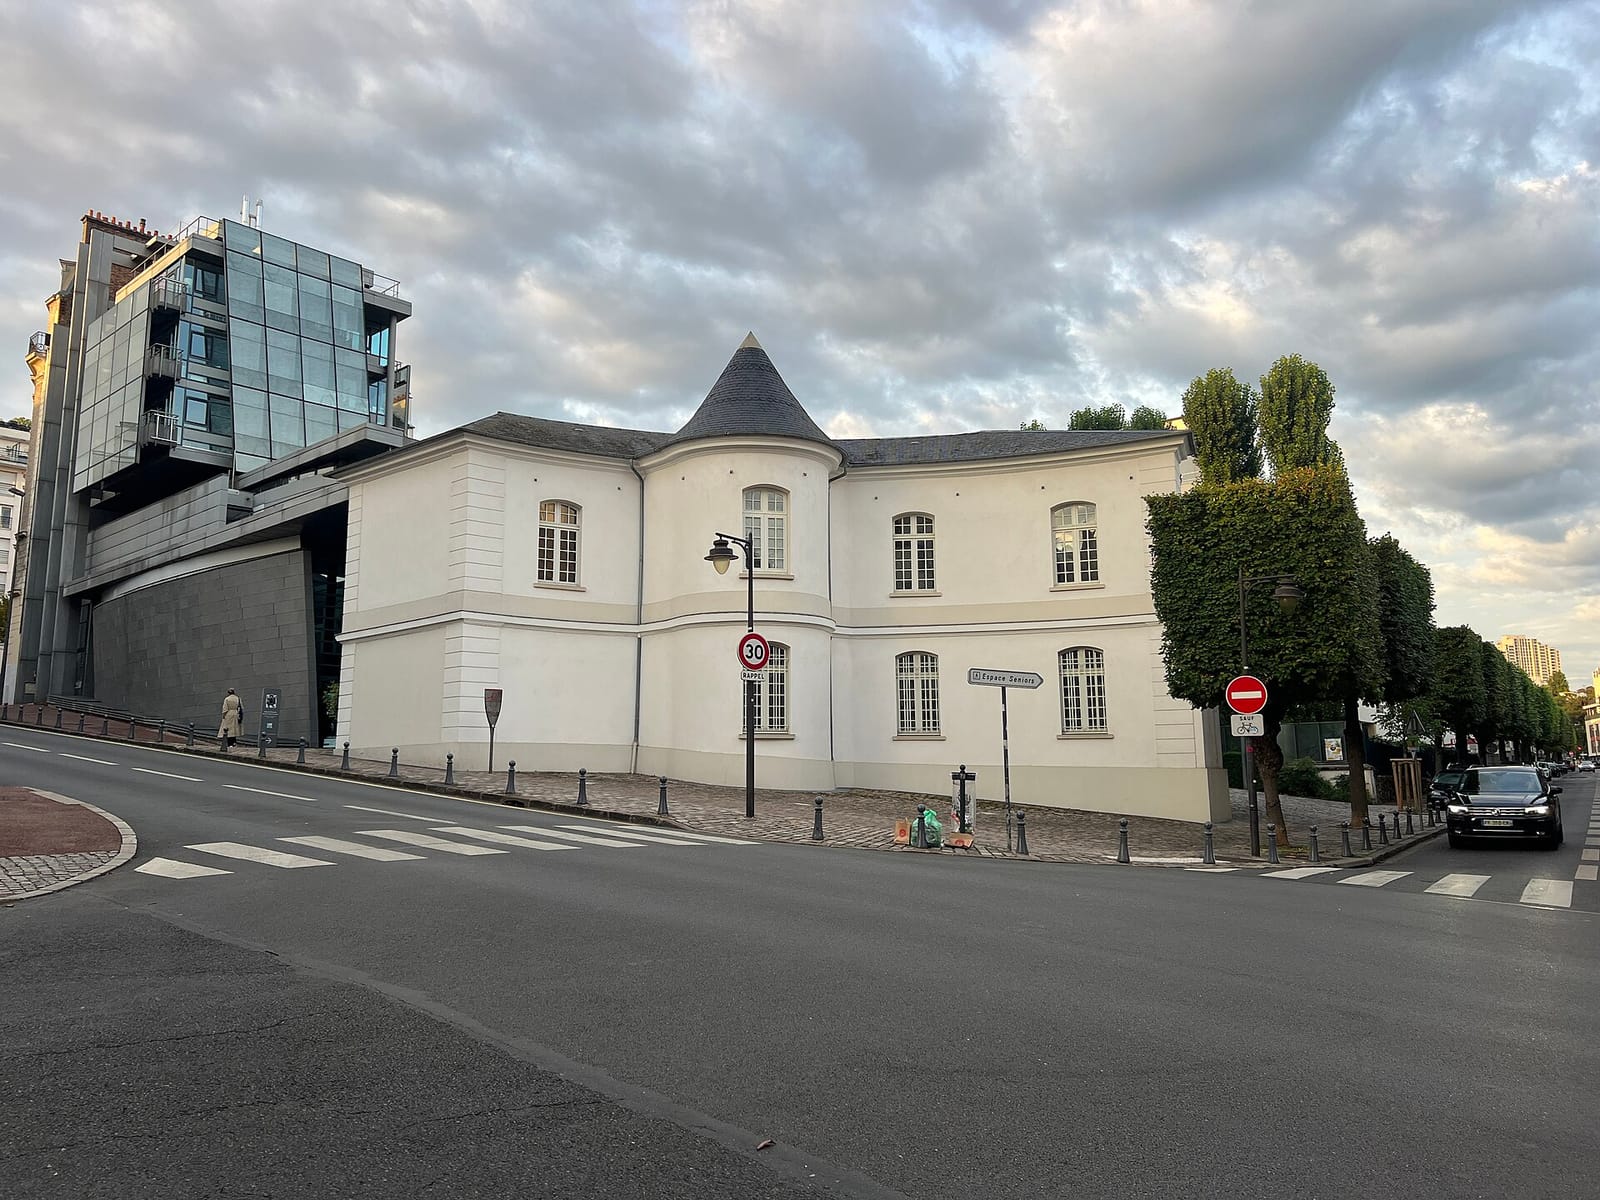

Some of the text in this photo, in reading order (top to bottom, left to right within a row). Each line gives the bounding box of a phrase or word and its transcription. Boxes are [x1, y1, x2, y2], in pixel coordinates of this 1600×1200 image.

[745, 644, 764, 660] 30
[743, 672, 765, 680] RAPPEL
[982, 673, 1035, 684] Espace Seniors
